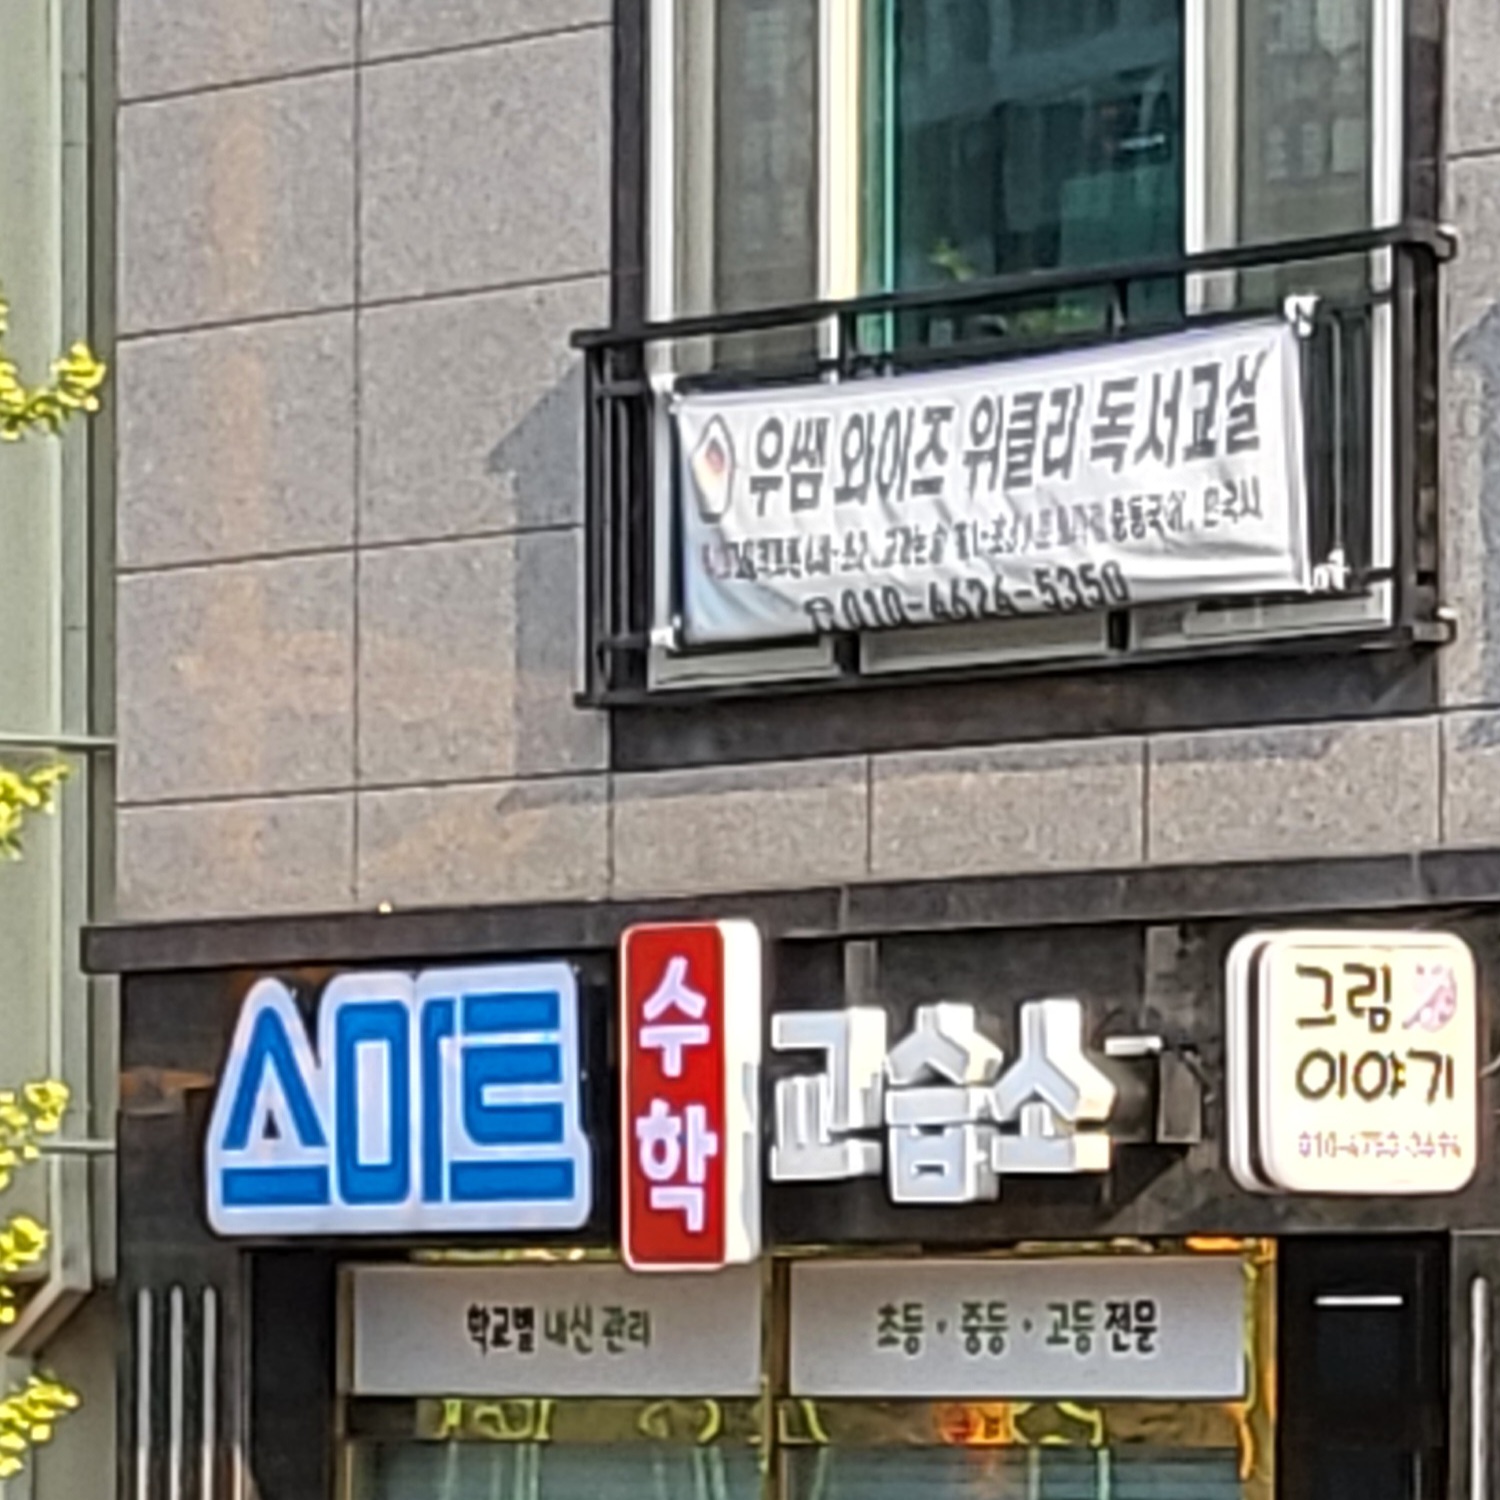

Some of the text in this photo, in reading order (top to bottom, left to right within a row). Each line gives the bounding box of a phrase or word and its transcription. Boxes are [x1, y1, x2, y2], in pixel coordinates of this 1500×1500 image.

[748, 350, 1271, 516] 우쌤 와이즈 위클리 독서교실
[1295, 964, 1393, 1031] 그림
[214, 957, 1116, 1232] 스마트 수학 교습소
[1295, 1049, 1455, 1103] 이야기
[467, 1303, 650, 1354] 학교별 내신 관리
[877, 1300, 1158, 1355] 초등 중등 고등 전문
